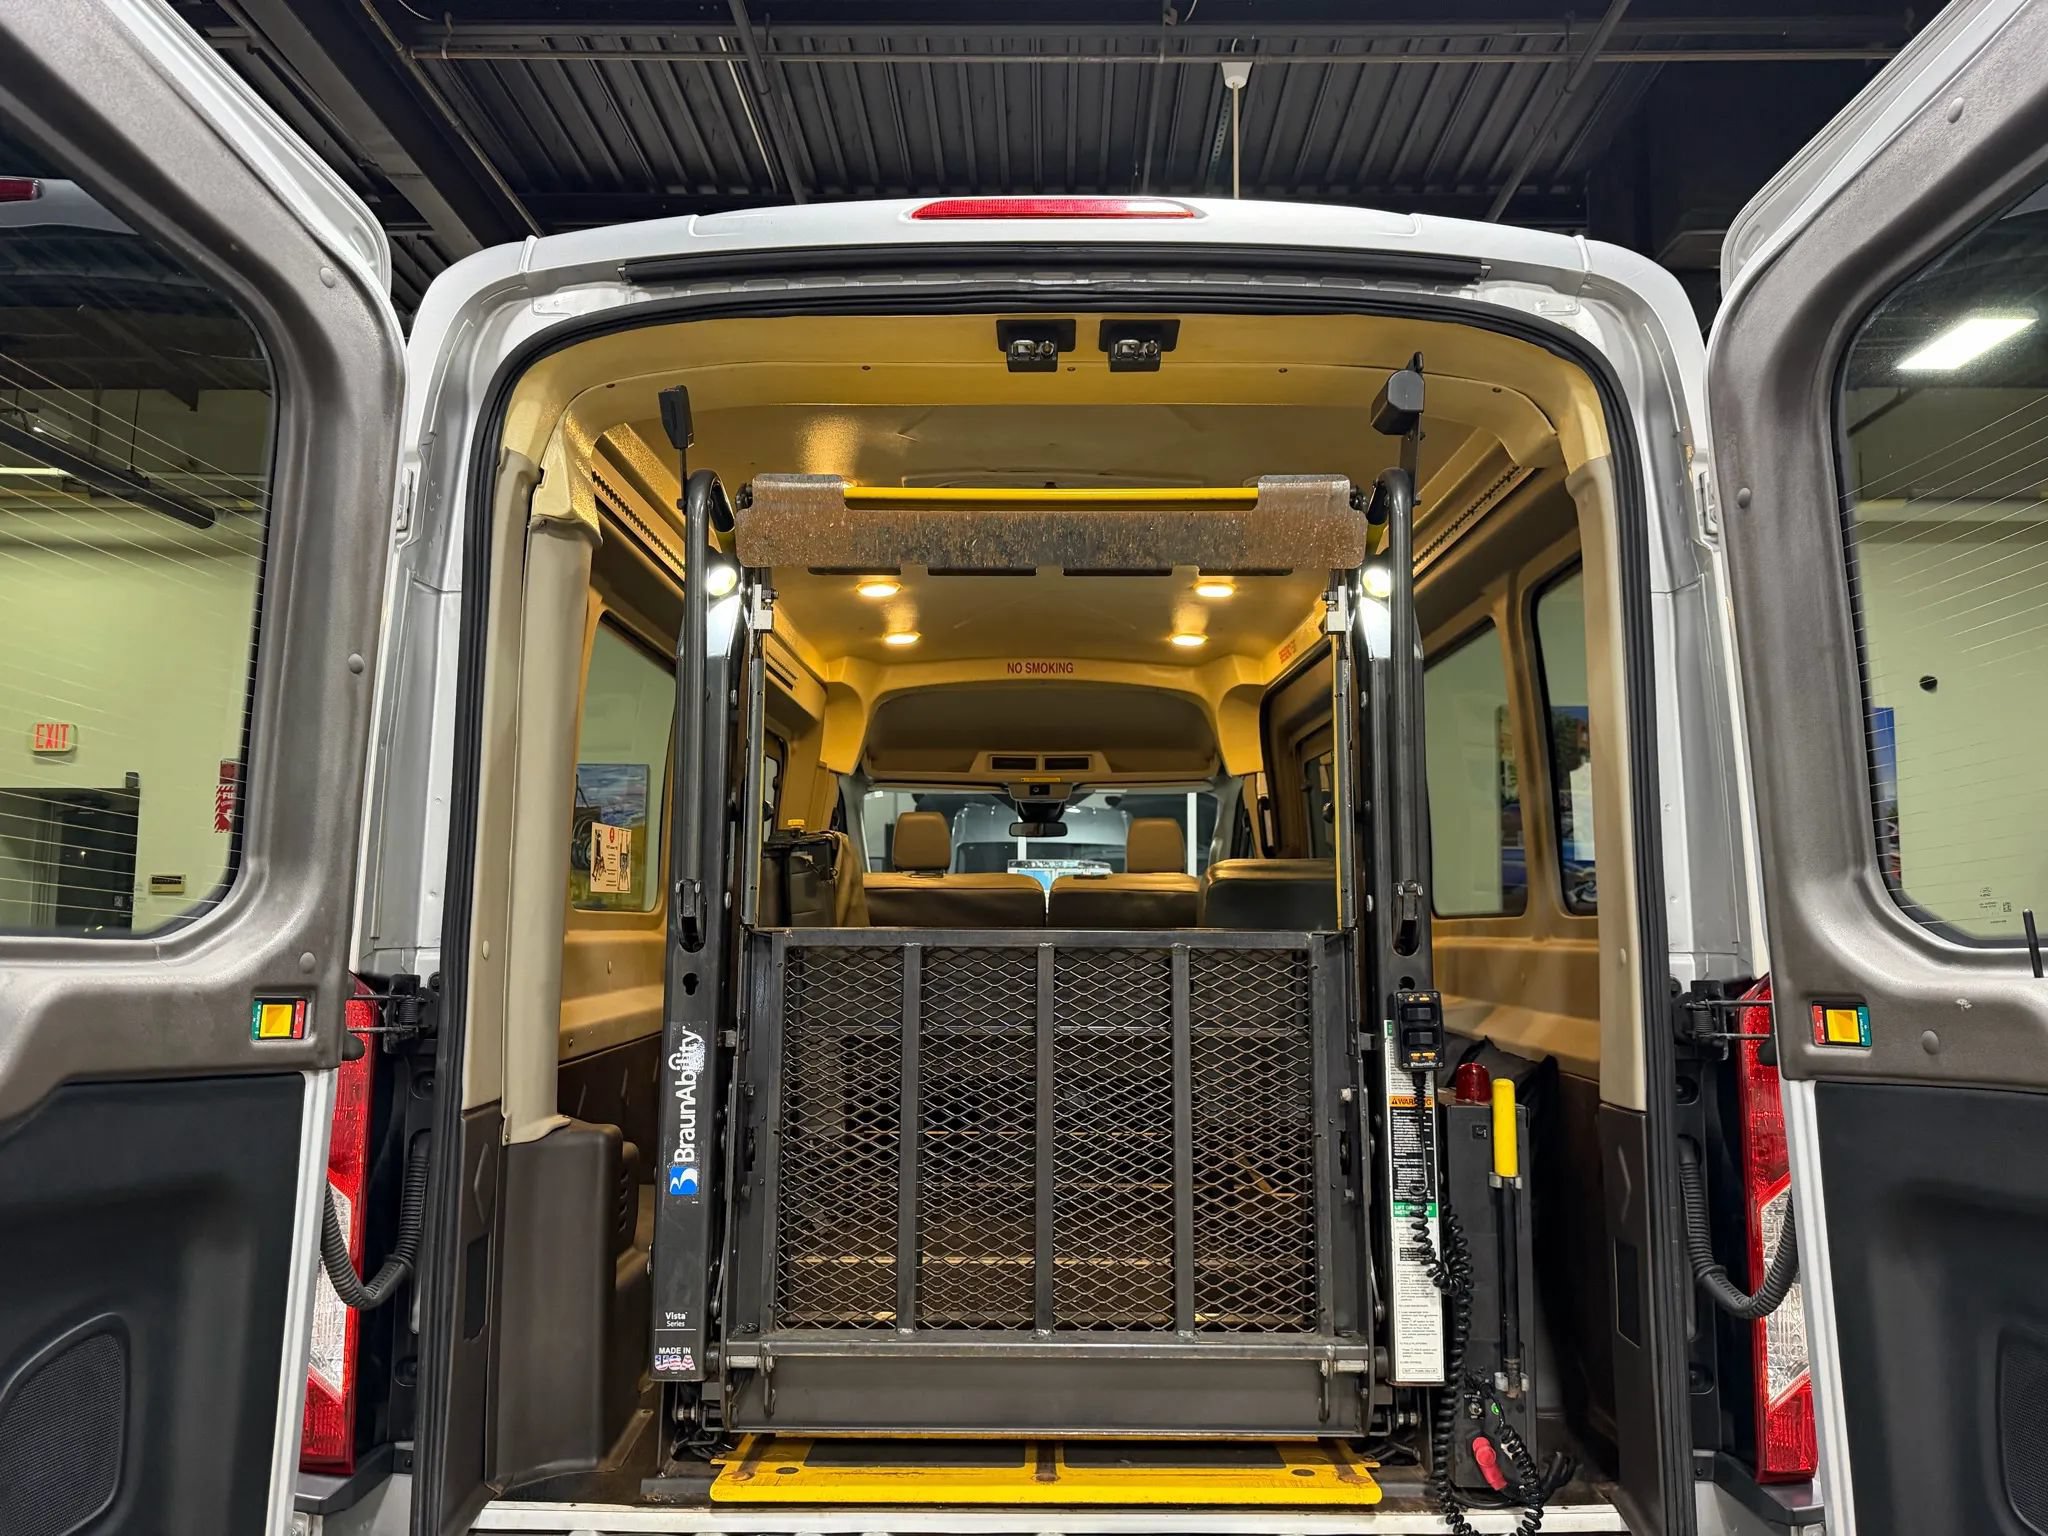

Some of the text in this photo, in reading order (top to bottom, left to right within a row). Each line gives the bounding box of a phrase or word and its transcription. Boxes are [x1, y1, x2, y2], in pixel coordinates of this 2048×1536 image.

[1007, 662, 1074, 674] NO SMOKING
[34, 723, 70, 749] EXIT
[668, 1027, 702, 1161] BraunAbility
[1397, 1098, 1432, 1106] WARG
[665, 1312, 686, 1320] Vista
[655, 1355, 696, 1371] USA
